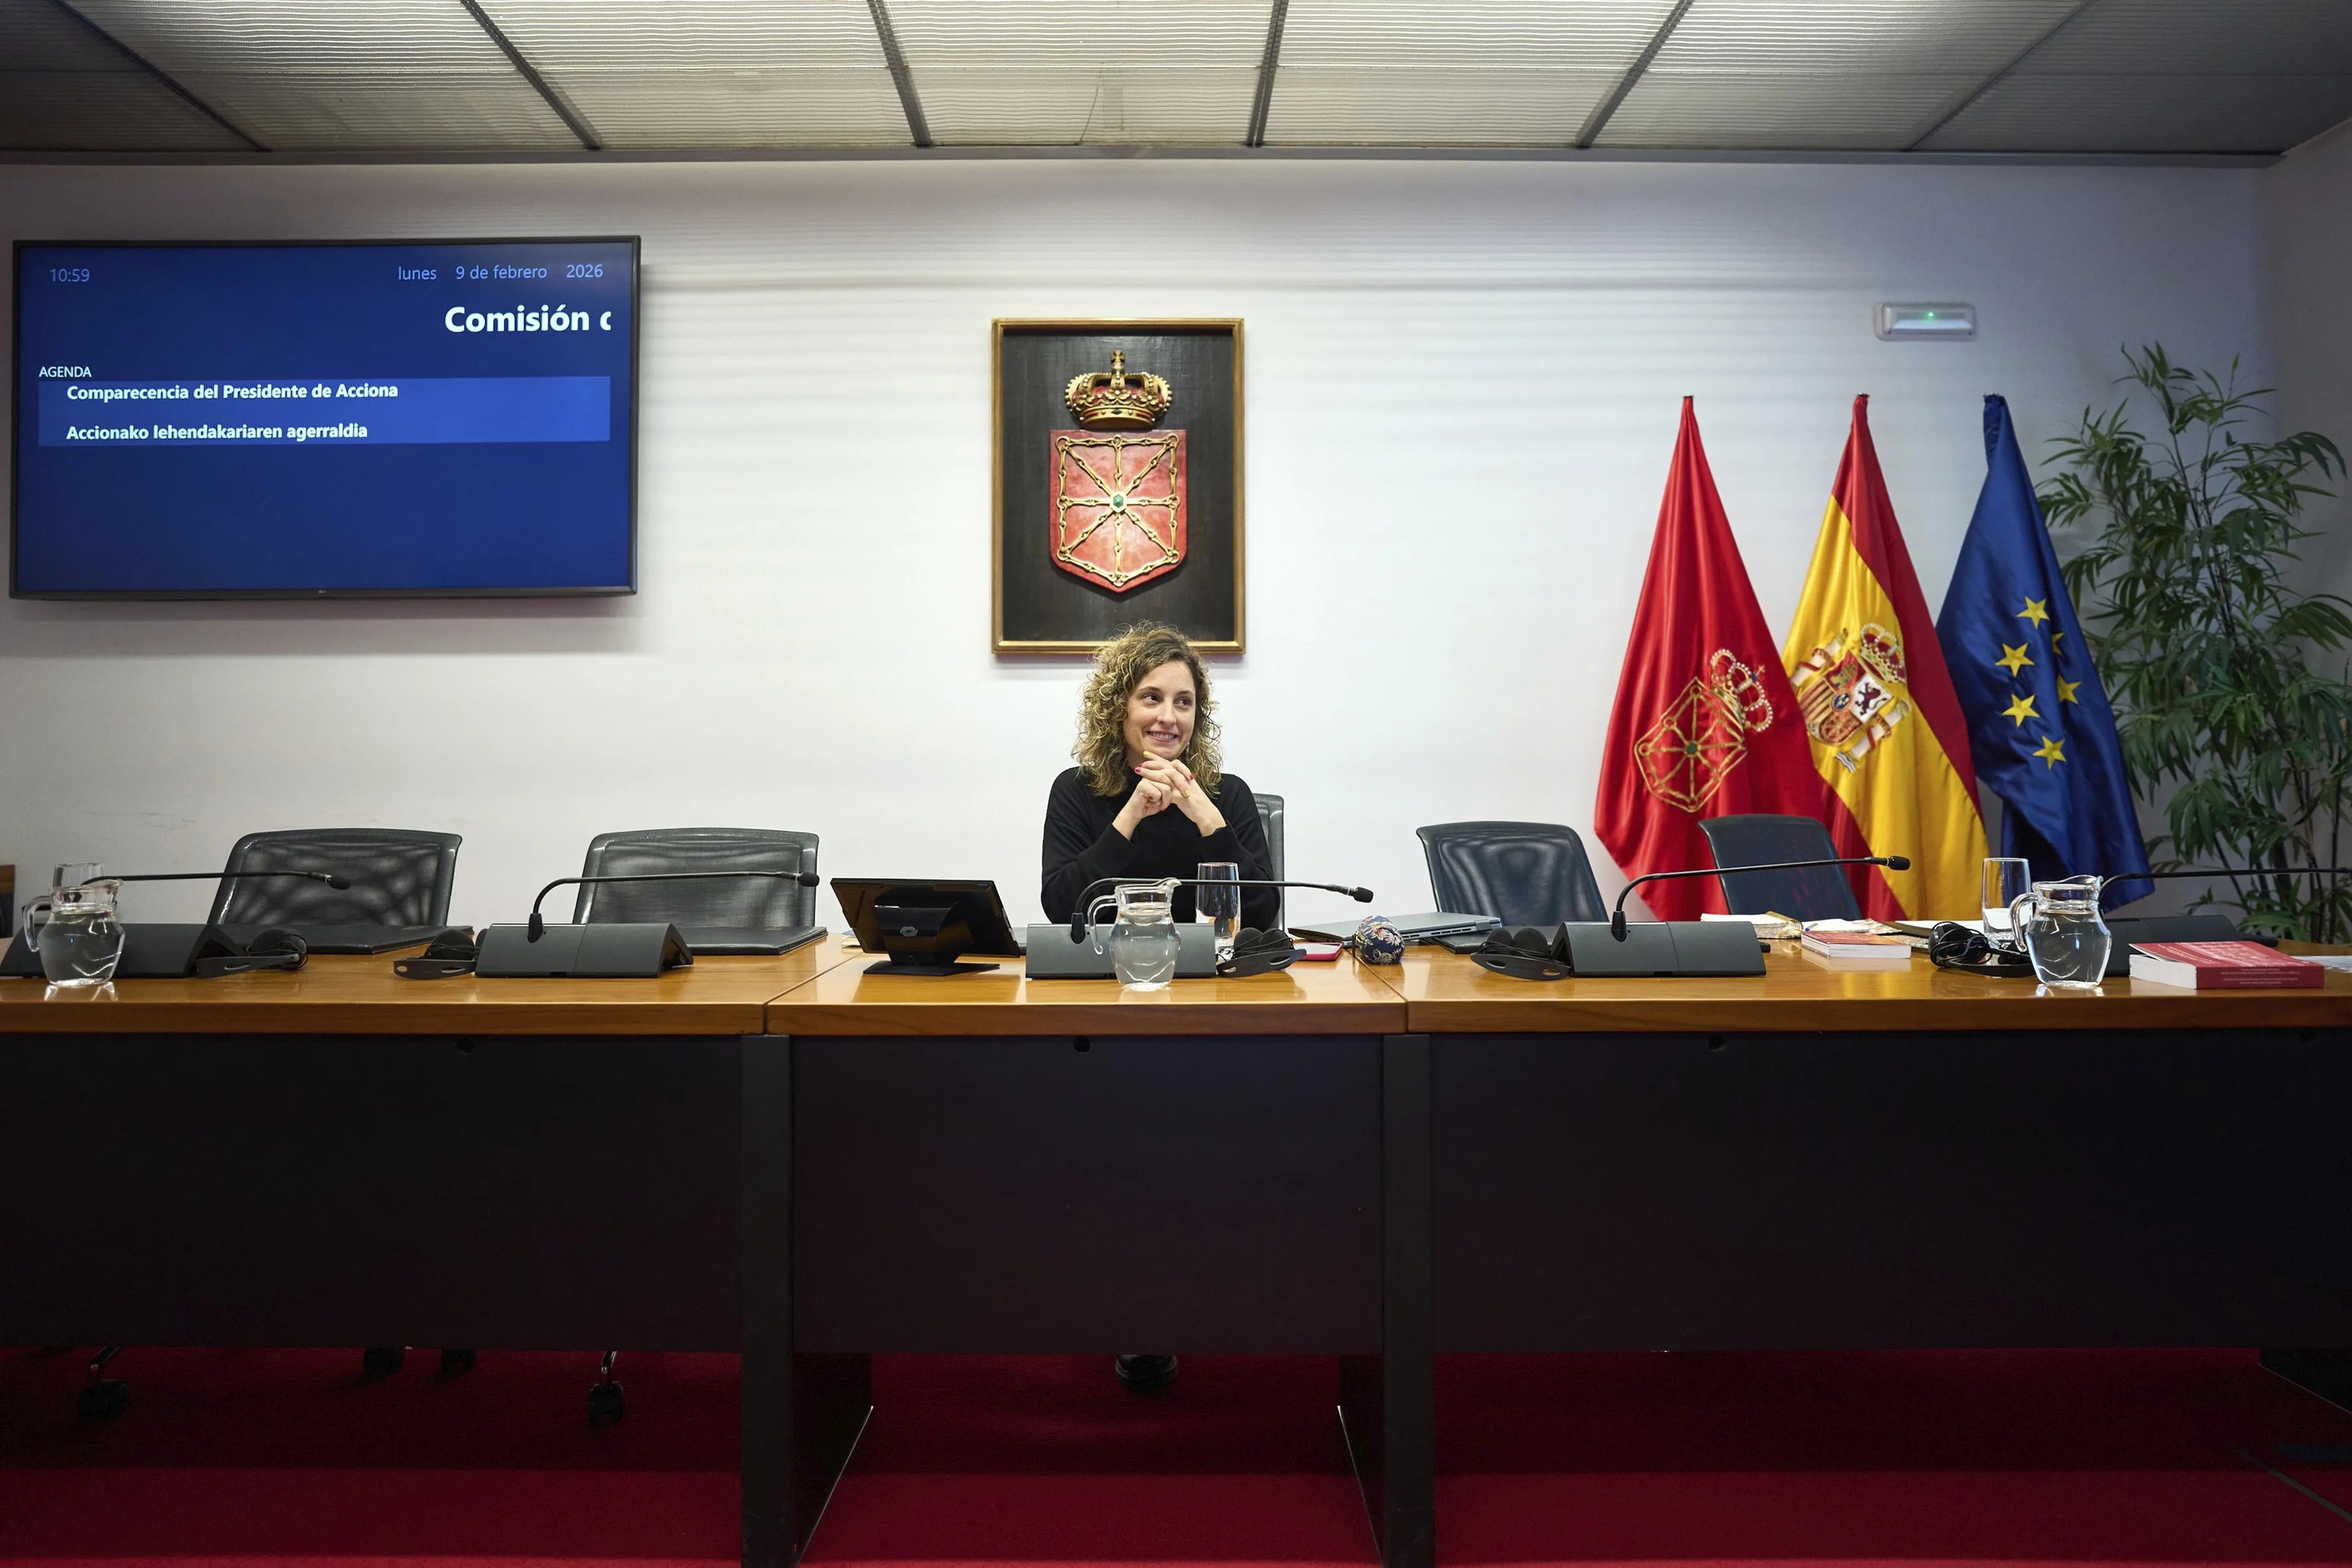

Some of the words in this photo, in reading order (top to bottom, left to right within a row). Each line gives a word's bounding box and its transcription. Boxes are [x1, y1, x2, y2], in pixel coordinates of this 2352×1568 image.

[50, 268, 90, 283] 10:59
[398, 266, 437, 281] lunes
[456, 266, 465, 279] 9
[470, 265, 489, 279] de
[493, 264, 548, 279] febrero
[566, 264, 604, 278] 2026
[444, 303, 590, 333] Comisión
[39, 366, 92, 378] AGENDA
[66, 384, 189, 404] Comparecencia
[193, 384, 219, 399] del
[223, 383, 308, 400] Presidente
[311, 382, 332, 398] de
[335, 382, 399, 398] Acciona
[66, 424, 150, 440] Accionako
[153, 423, 283, 440] lehendakariaren
[286, 422, 368, 443] agerraldia
